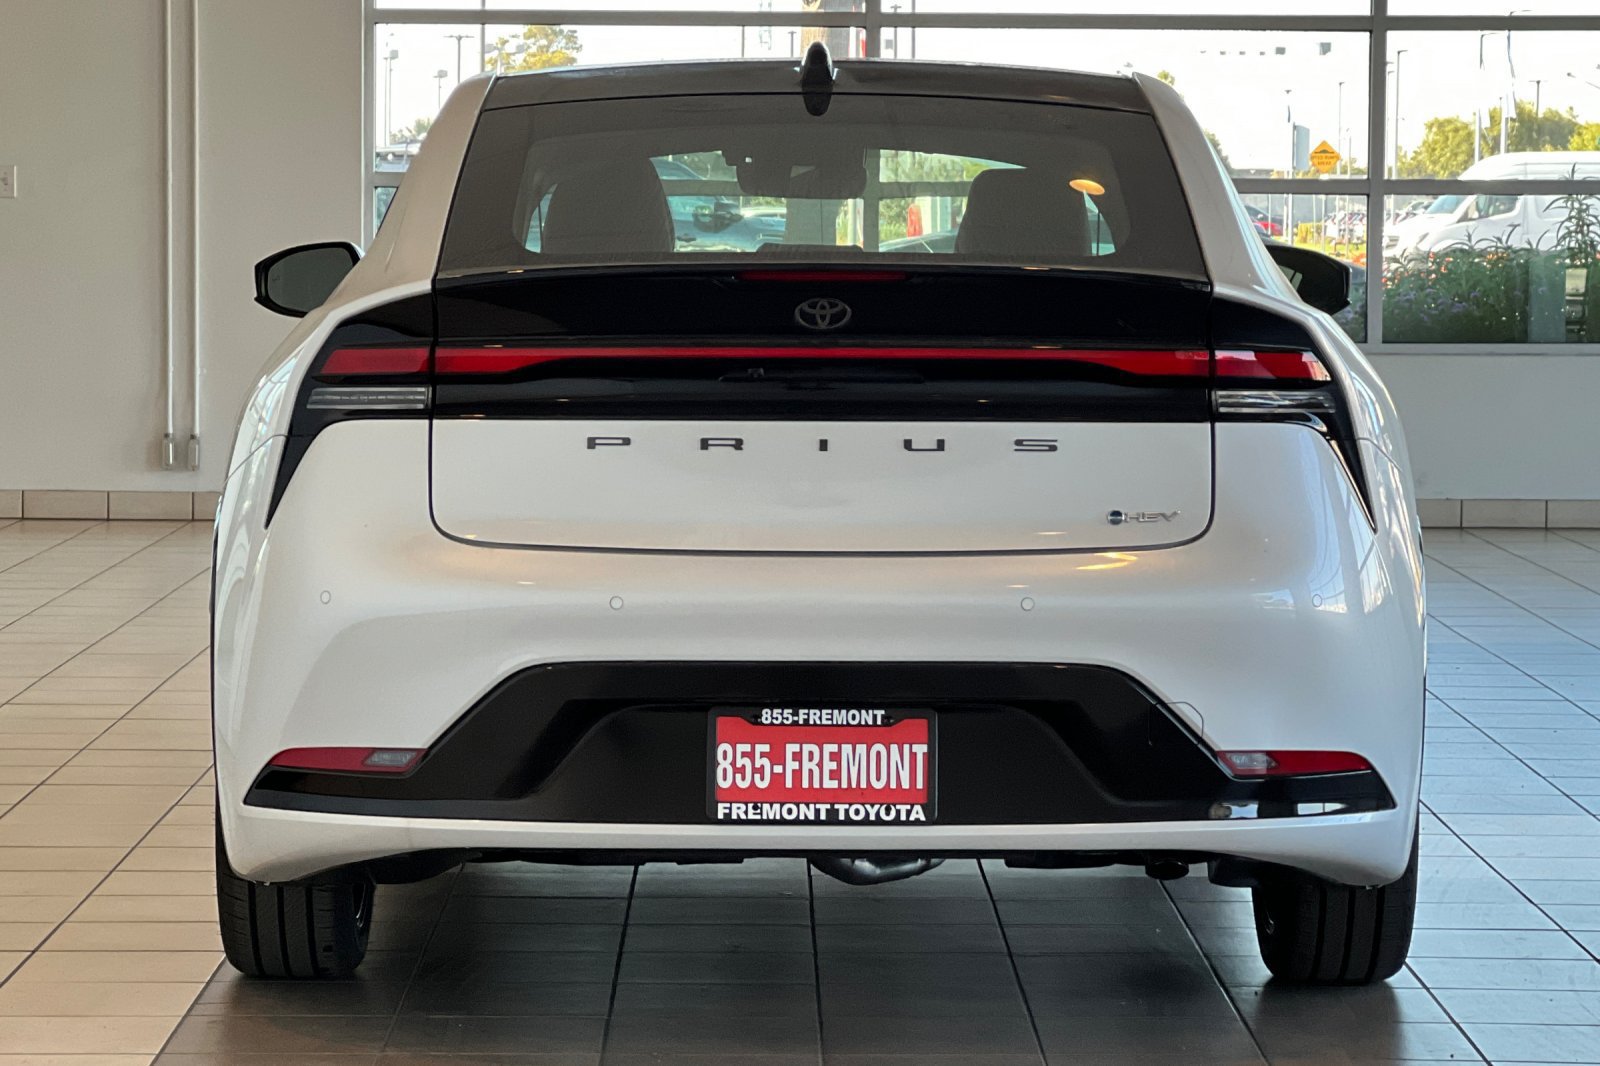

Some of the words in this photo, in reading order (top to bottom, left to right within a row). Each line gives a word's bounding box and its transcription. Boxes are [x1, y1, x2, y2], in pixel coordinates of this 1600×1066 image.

[586, 436, 1058, 453] PRIUS
[1124, 510, 1181, 524] HEV
[761, 708, 885, 726] 855-FREMONT
[716, 742, 928, 790] 855-FREMONT
[717, 802, 831, 820] FREMONT
[834, 804, 926, 822] TOYOTA
